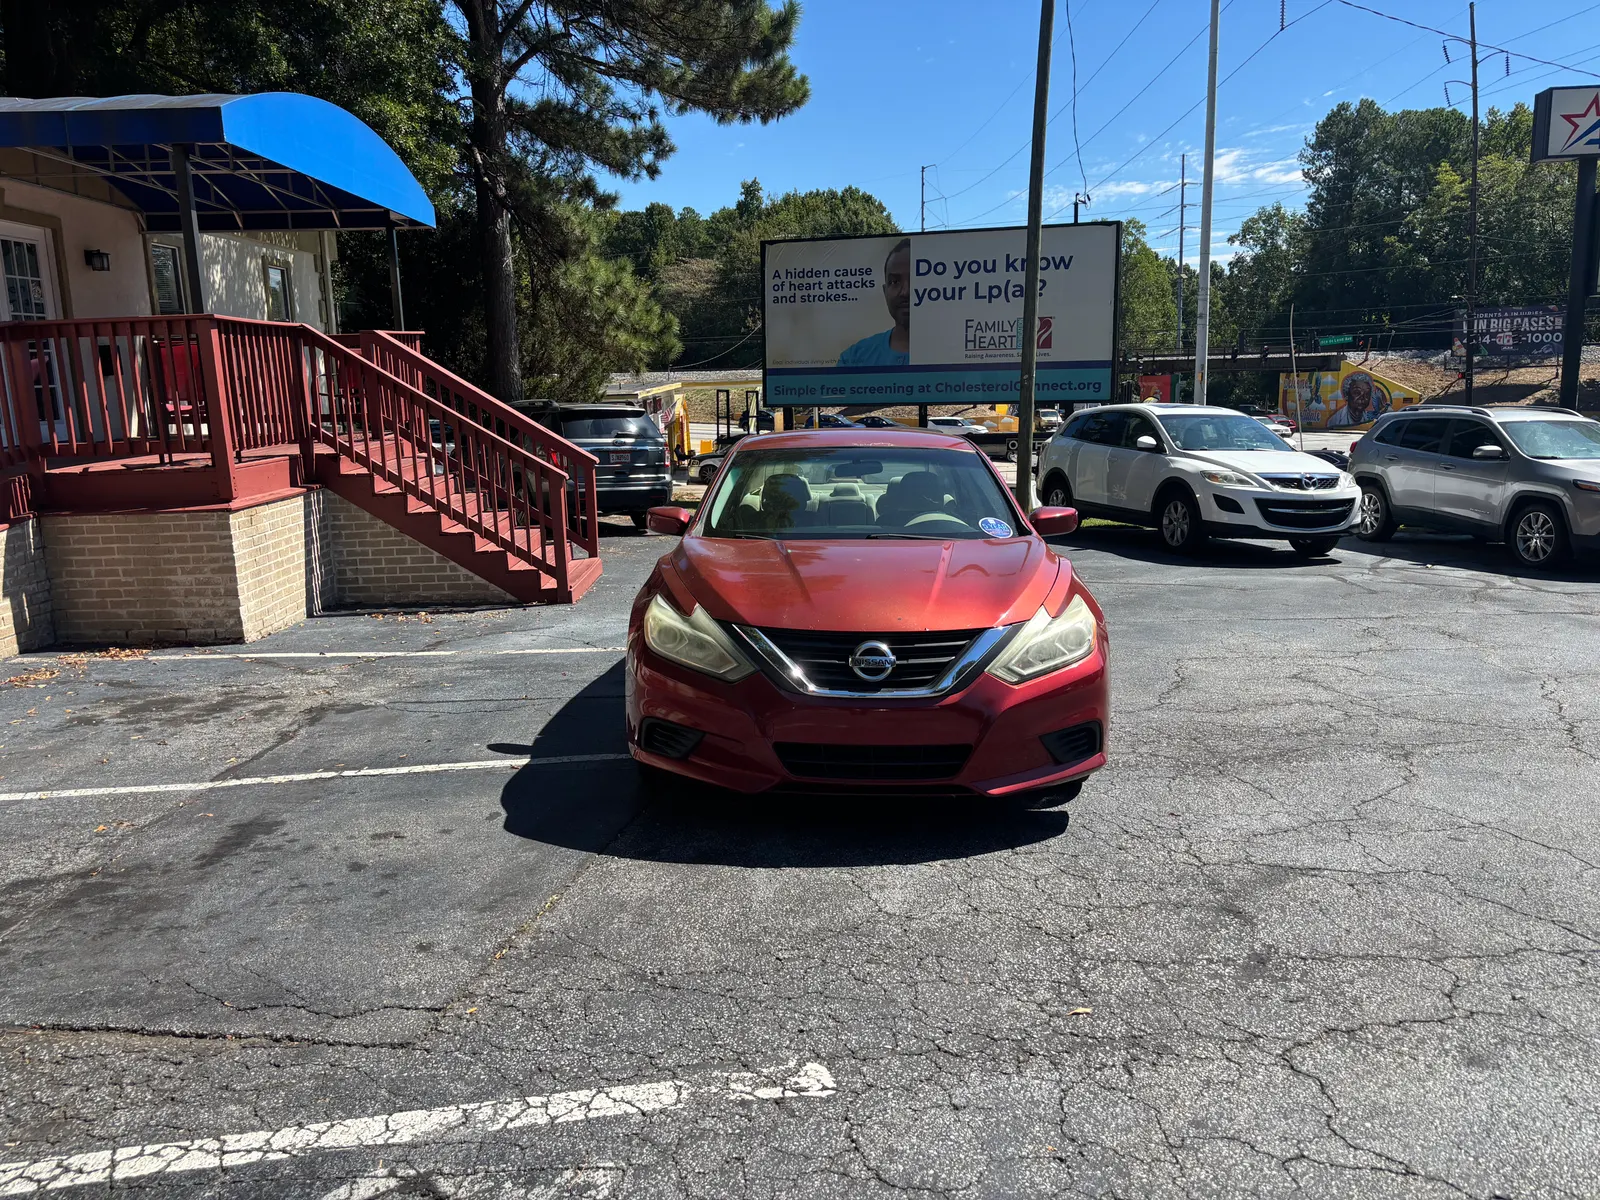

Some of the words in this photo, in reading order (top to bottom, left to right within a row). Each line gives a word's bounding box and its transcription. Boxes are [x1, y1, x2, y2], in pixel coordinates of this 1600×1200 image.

[772, 270, 782, 280] A
[786, 268, 830, 280] hidden
[834, 267, 872, 278] cause
[916, 258, 947, 276] Do
[953, 259, 997, 280] you
[772, 281, 786, 292] of
[789, 280, 823, 292] heart
[827, 278, 876, 290] attacks
[914, 286, 966, 306] your
[974, 279, 1046, 304] Lp(a?
[772, 293, 796, 304] and
[800, 292, 858, 303] strokes...
[965, 319, 1016, 334] FAMILY
[1490, 318, 1510, 332] BIG
[1514, 316, 1554, 332] CASES
[965, 334, 1016, 350] HEART
[774, 385, 817, 398] Simple
[821, 384, 846, 396] free
[850, 383, 914, 396] screening
[918, 384, 932, 393] at
[935, 380, 1102, 394] CholesterolCnnect.org
